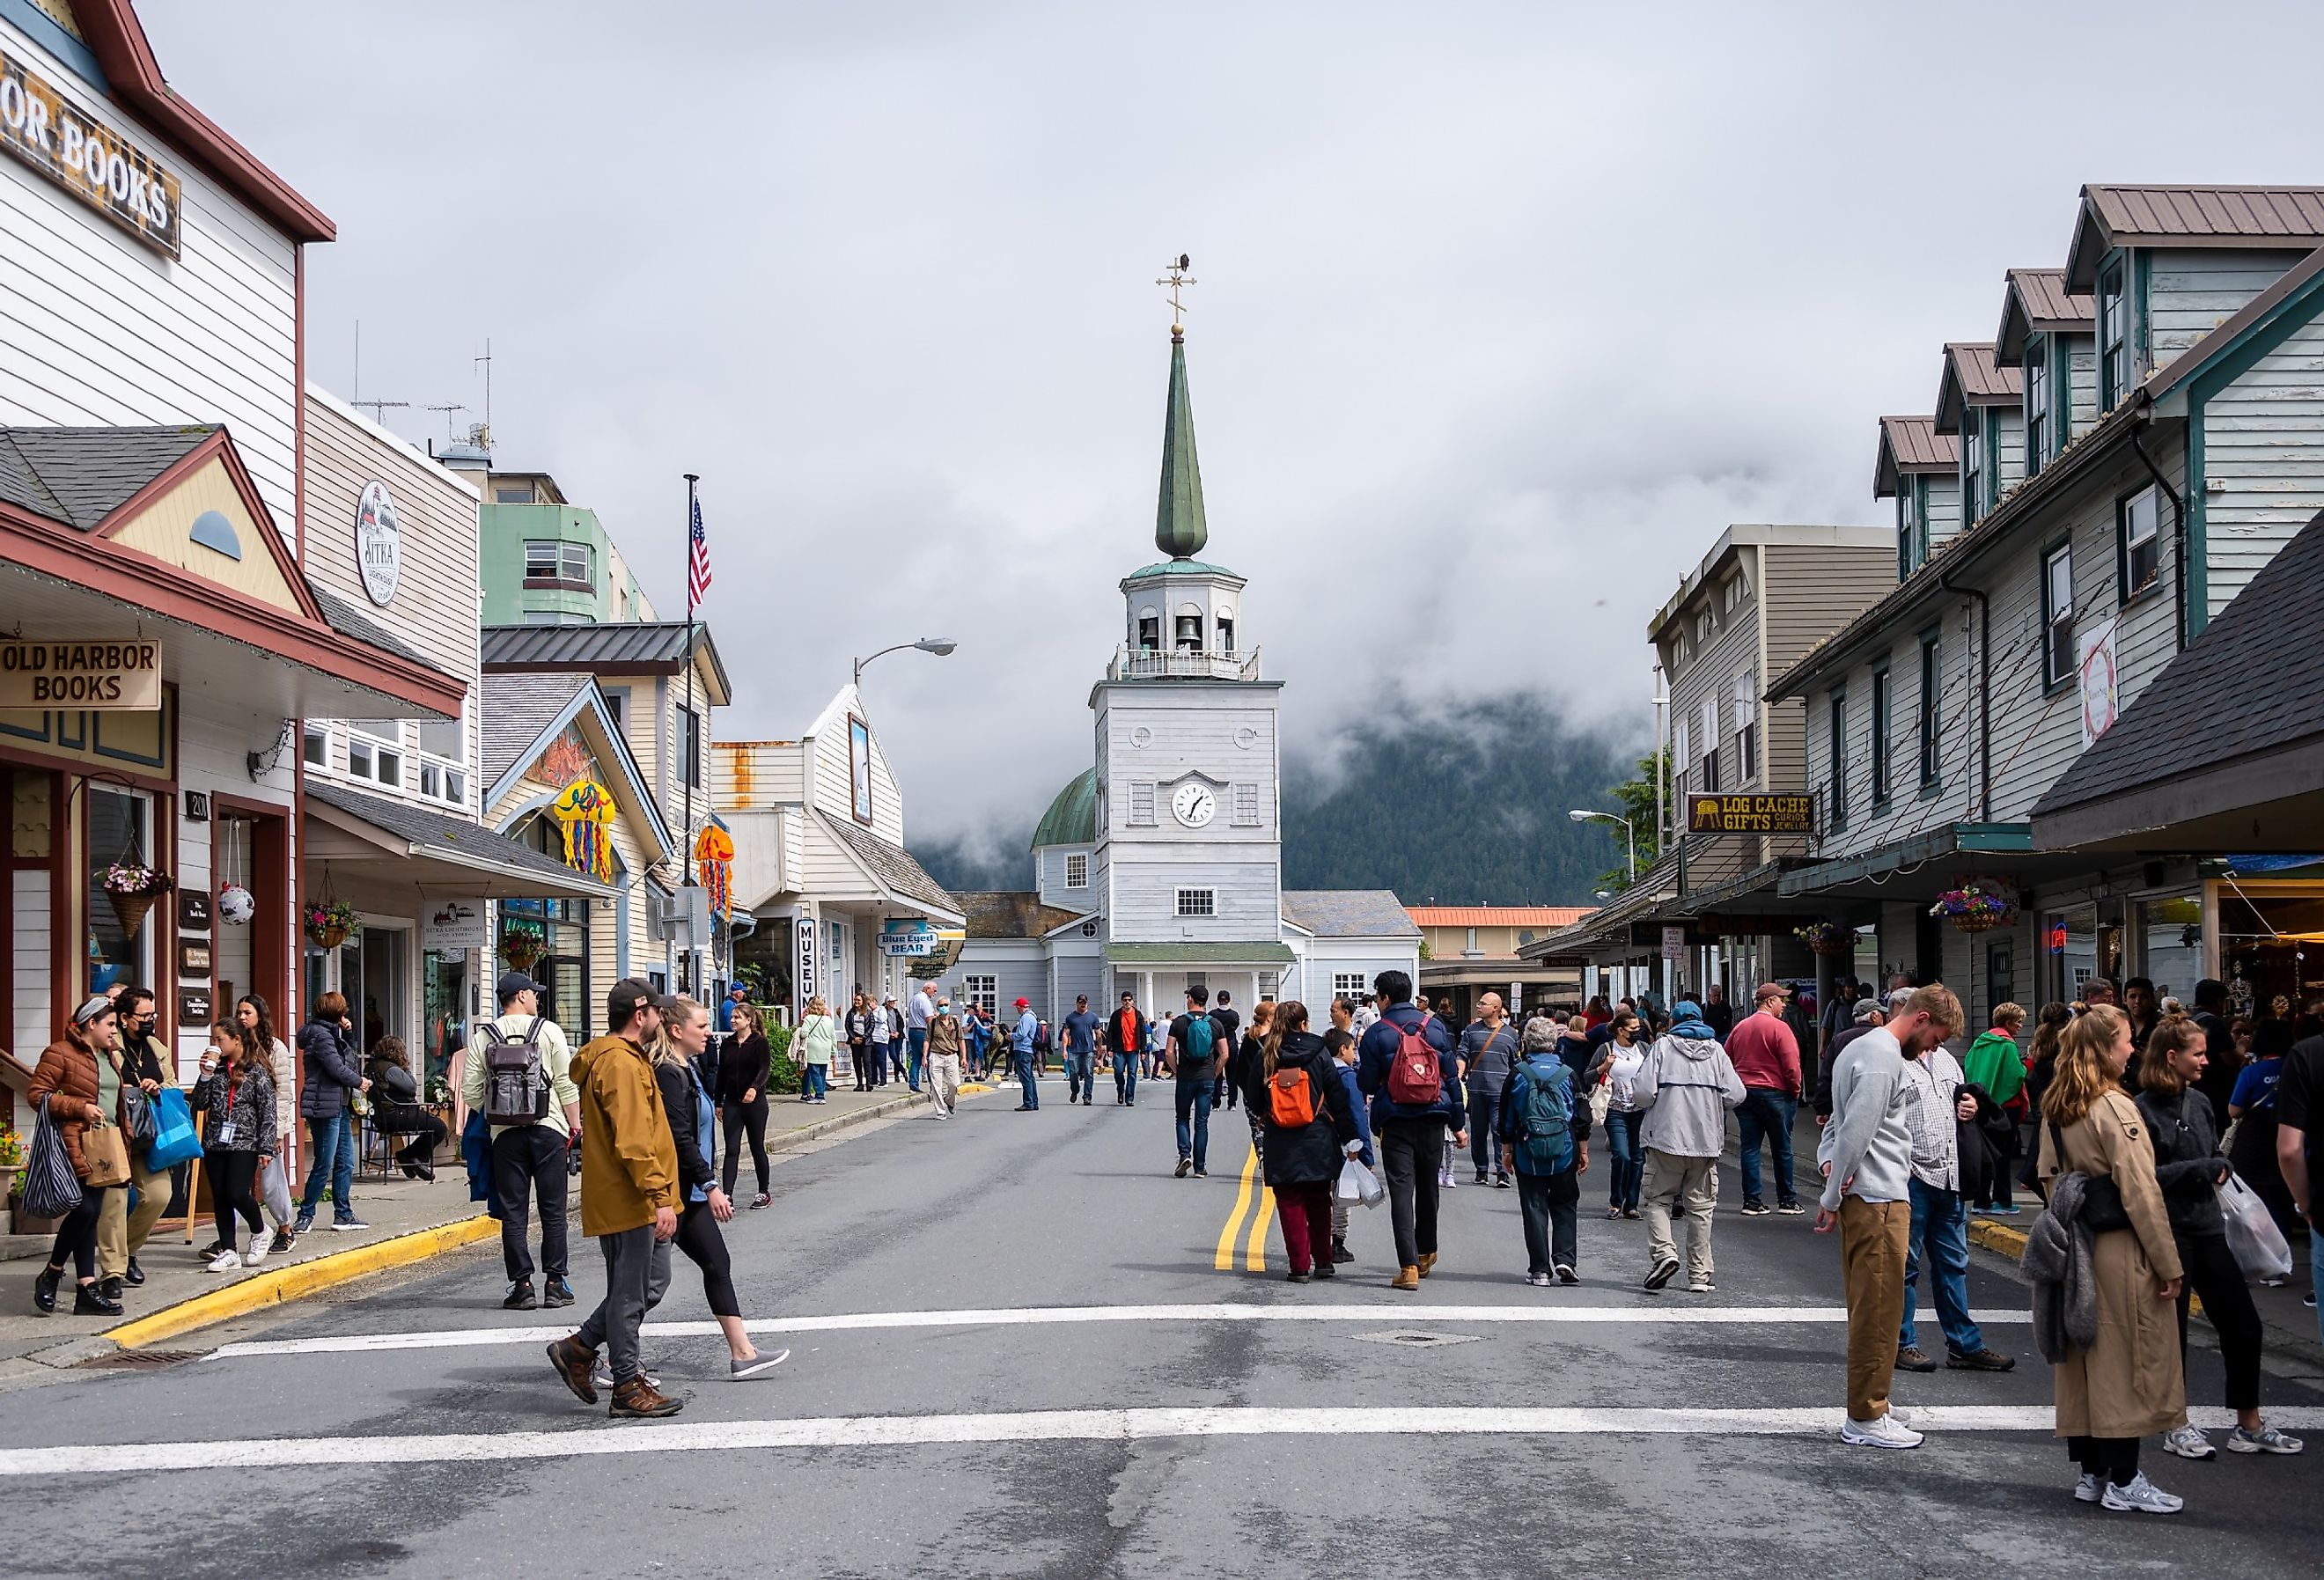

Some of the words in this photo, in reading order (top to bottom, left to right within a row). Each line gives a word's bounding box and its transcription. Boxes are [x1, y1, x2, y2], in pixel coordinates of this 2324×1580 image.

[62, 115, 167, 229] BOOKS
[364, 535, 393, 564] SITKA
[4, 645, 47, 671] OLD
[54, 645, 154, 671] HARBOR
[34, 675, 121, 701] BOOKS
[192, 795, 207, 817] 201
[1722, 797, 1750, 813] LOG
[1755, 797, 1809, 813] CACHE
[1724, 813, 1771, 830] GIFTS
[1774, 812, 1806, 821] CURIOS
[1773, 821, 1810, 830] JEWELRY
[907, 934, 933, 944] Eyed
[891, 944, 924, 953] BEAR
